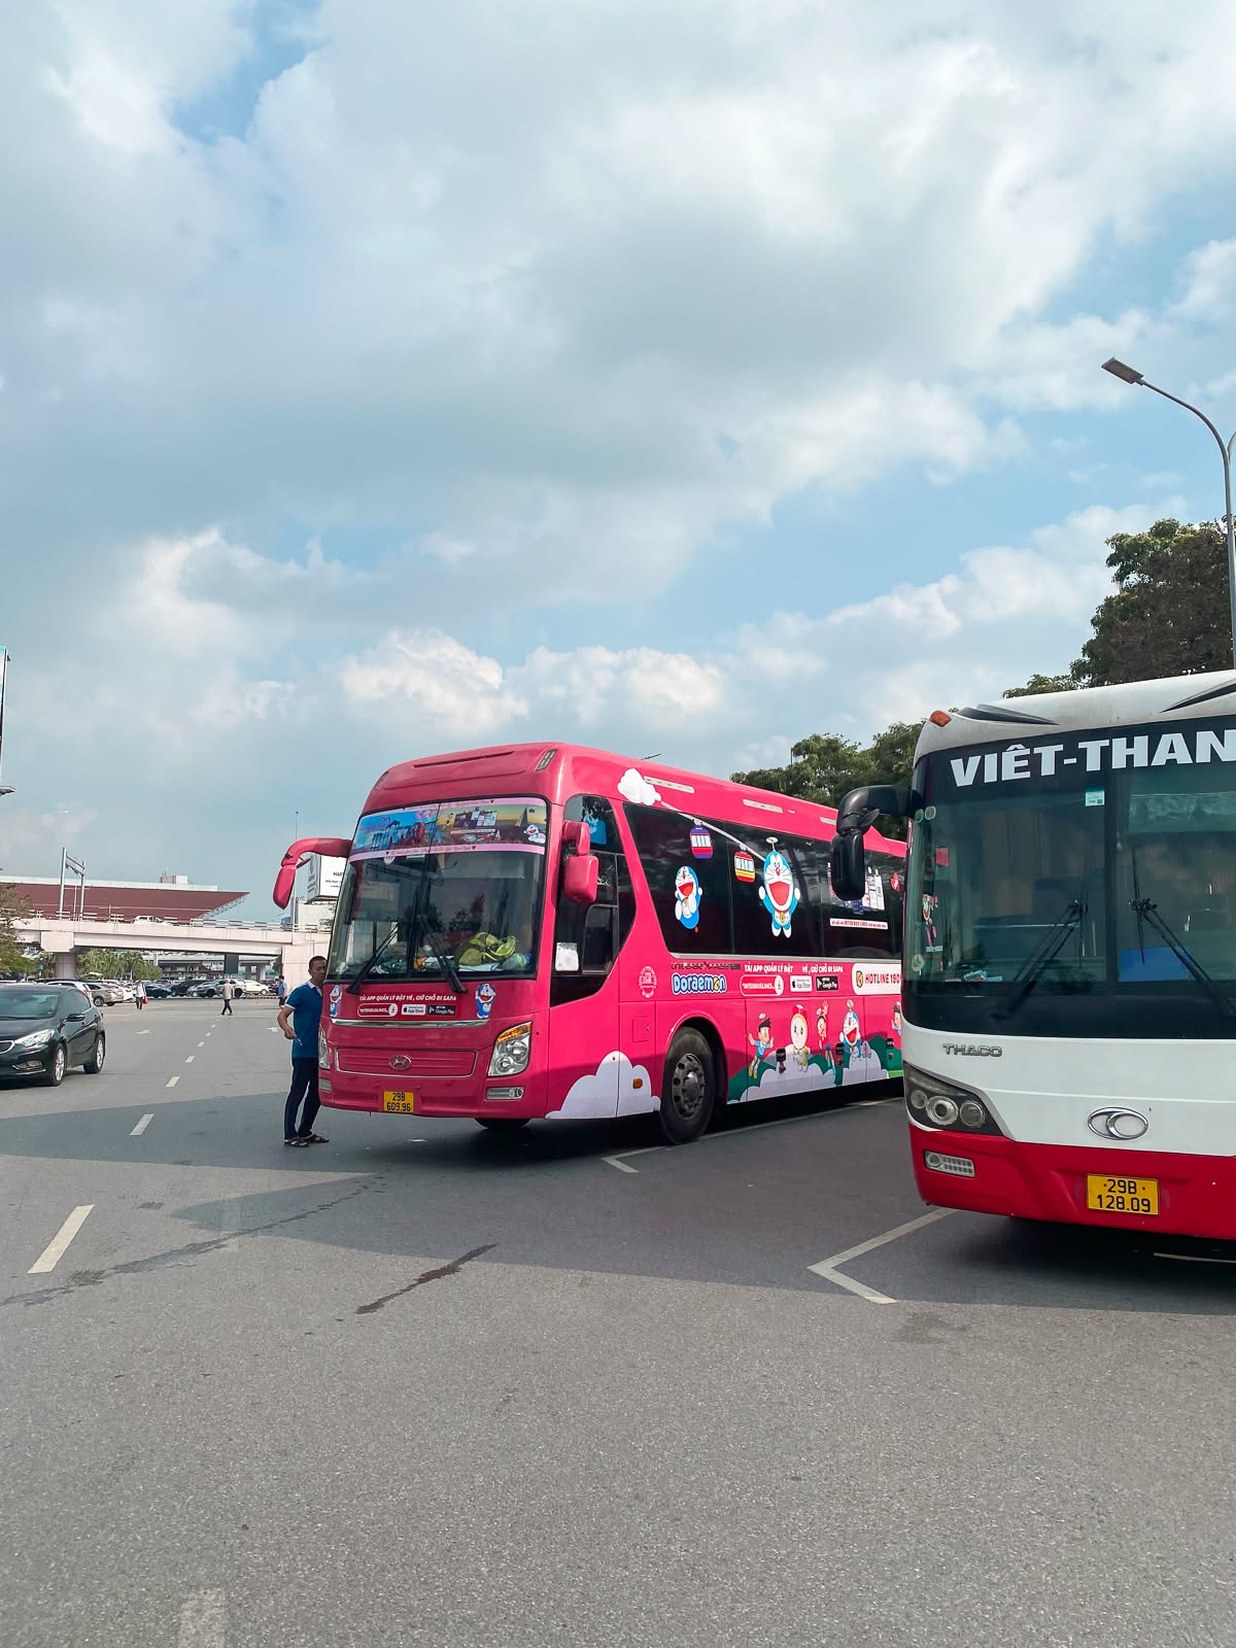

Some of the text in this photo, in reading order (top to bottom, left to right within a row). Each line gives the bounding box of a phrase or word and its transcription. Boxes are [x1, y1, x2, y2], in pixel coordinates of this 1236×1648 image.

[672, 974, 726, 994] Doraemon
[865, 974, 889, 984] HOTLINE
[942, 1043, 1002, 1057] THACO
[392, 1092, 405, 1101] 29B
[1108, 1179, 1137, 1194] 29B
[1097, 1194, 1150, 1212] 128.09
